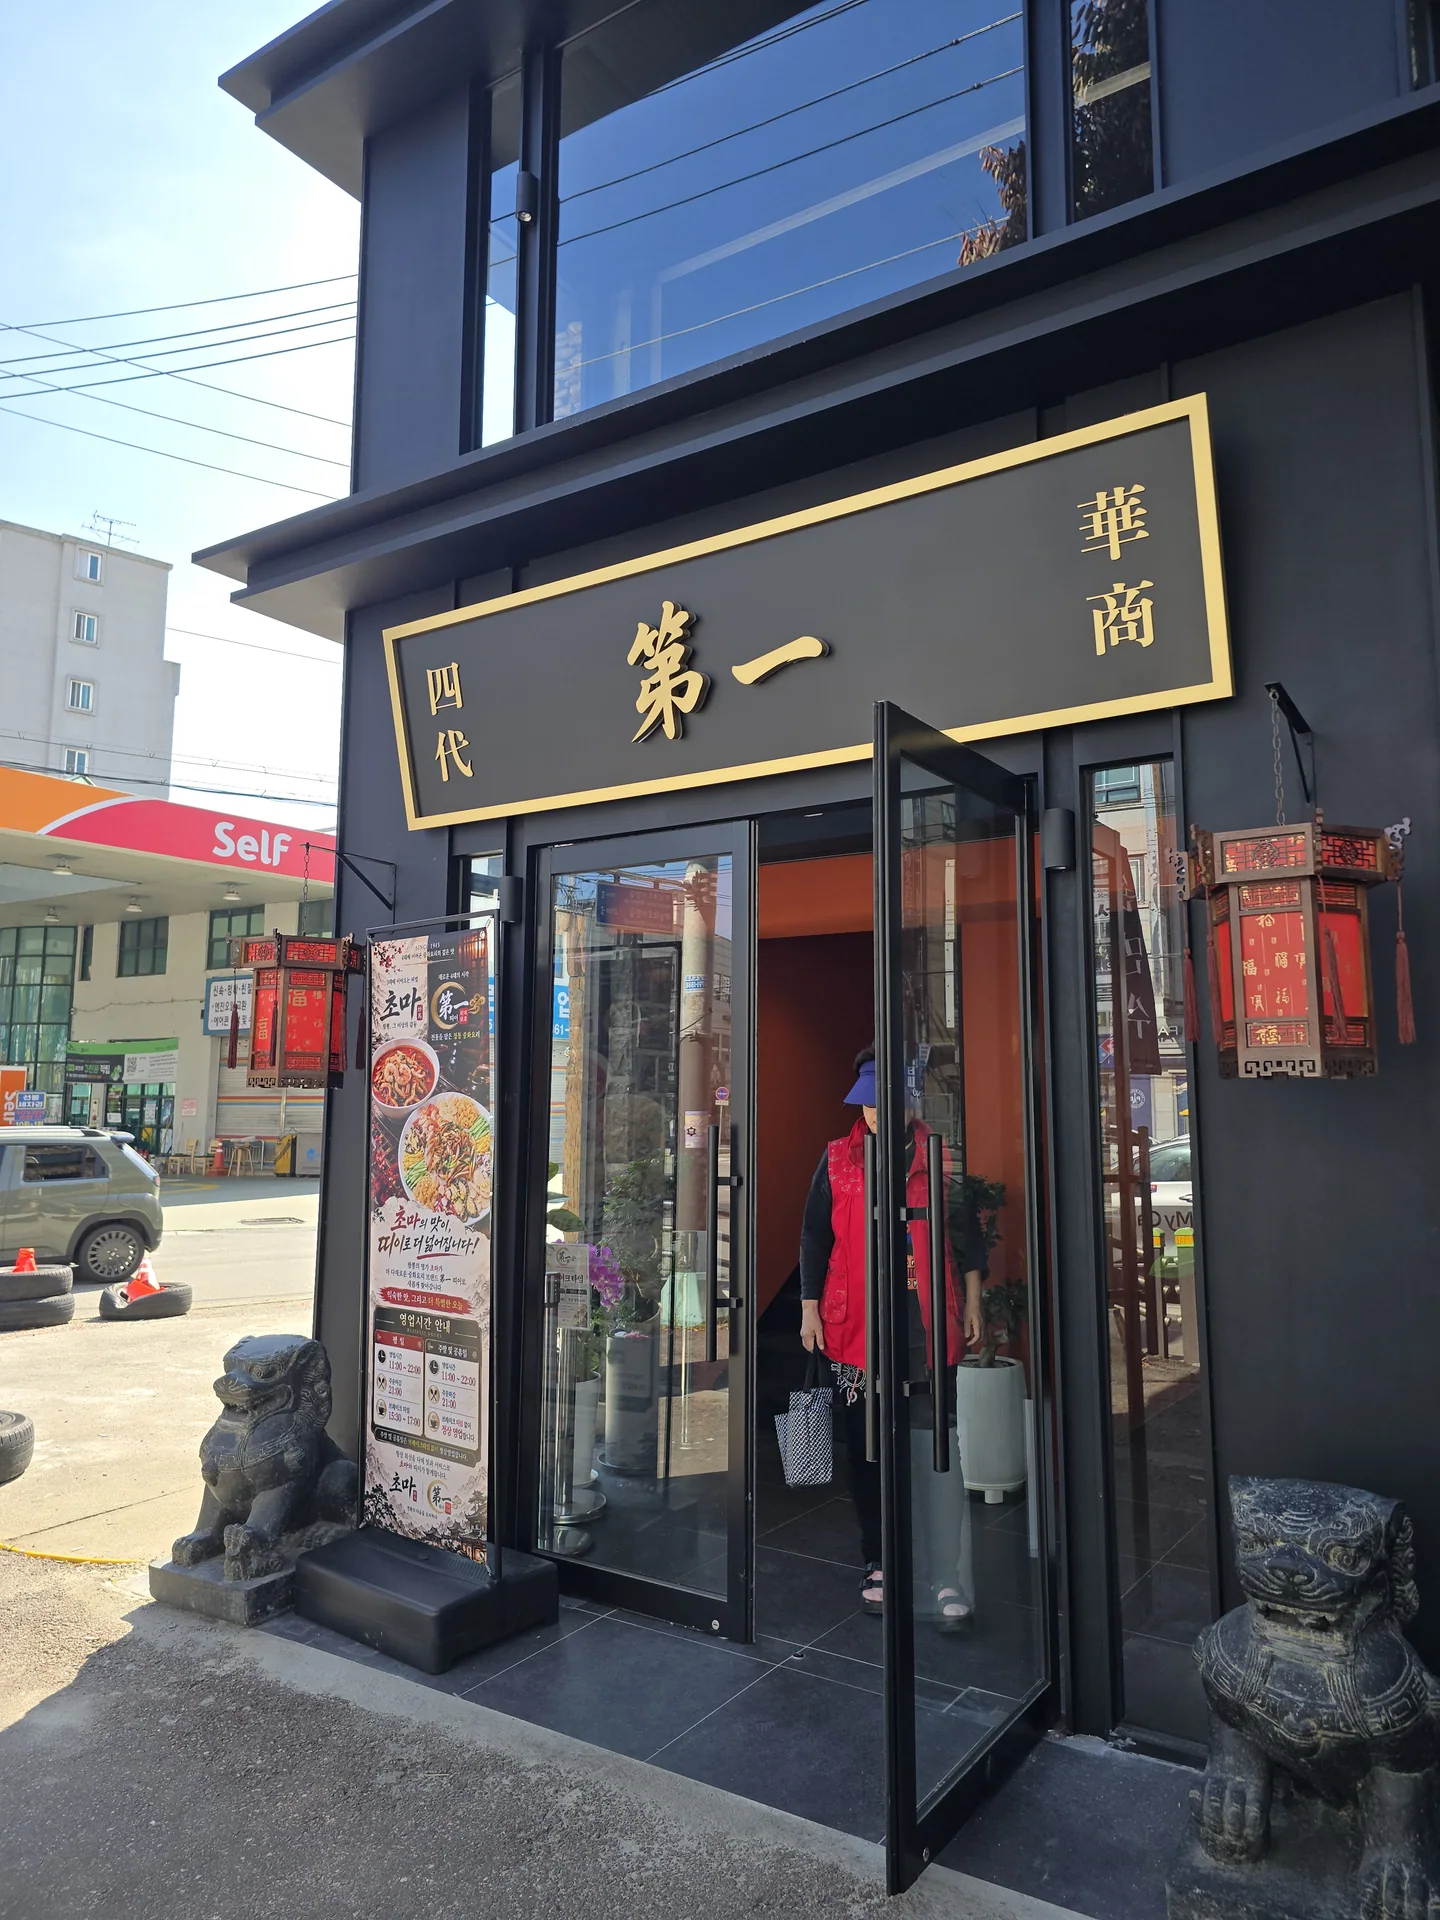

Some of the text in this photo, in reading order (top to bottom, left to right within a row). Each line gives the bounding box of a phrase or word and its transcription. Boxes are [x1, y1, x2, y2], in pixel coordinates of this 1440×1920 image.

[1077, 484, 1155, 657] 華商
[630, 600, 829, 744] 第一
[425, 661, 474, 783] 四代
[212, 821, 293, 867] Self
[380, 987, 422, 1021] 초마
[439, 990, 469, 1020] 第一
[3, 1090, 17, 1125] Self
[390, 1205, 451, 1233] 초마의 맛이,
[413, 1235, 423, 1254] 더
[424, 1234, 480, 1256] 넓어집니다!
[411, 1294, 427, 1304] 그리고
[428, 1297, 434, 1306] 더
[452, 1300, 463, 1311] 오늘
[399, 1312, 451, 1334] 영업시간 안내
[389, 1360, 402, 1371] 11:00
[408, 1363, 421, 1375] 22:00
[442, 1371, 455, 1382] 11:00
[460, 1375, 476, 1386] 22:00
[442, 1399, 456, 1409] 21:00
[388, 1411, 402, 1422] 15:30
[407, 1415, 420, 1427] 17:00
[441, 1425, 452, 1437] 정상
[389, 1471, 416, 1499] 초마
[432, 1485, 451, 1506] 第一
